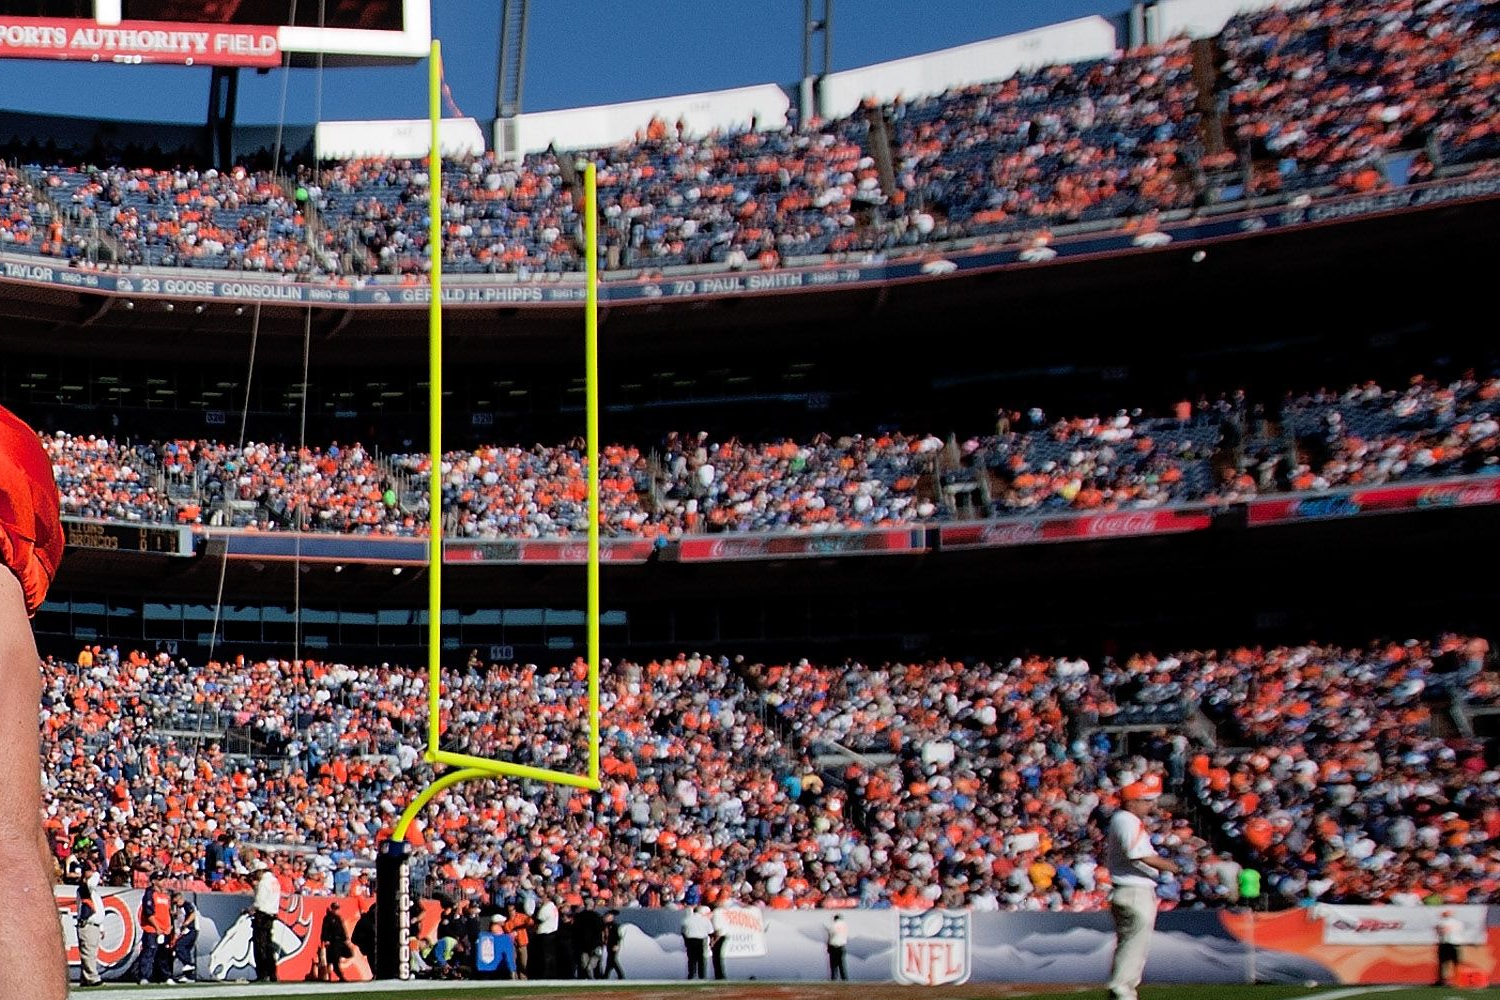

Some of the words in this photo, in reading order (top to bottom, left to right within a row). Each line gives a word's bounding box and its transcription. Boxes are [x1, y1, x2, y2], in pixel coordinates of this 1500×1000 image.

[71, 28, 209, 53] AUTHORITY
[214, 33, 278, 56] FIELD
[5, 262, 53, 281] TAYLOR
[141, 278, 160, 292] 23
[164, 279, 215, 295] GOOSE
[221, 283, 302, 299] GONSOULIN
[469, 288, 485, 301] H.
[486, 287, 543, 301] PHIPPS
[674, 279, 695, 295] 70
[703, 277, 746, 294] PAUL
[750, 272, 803, 289] SMITH
[69, 522, 105, 535] LIONS
[69, 534, 119, 550] BRONCOS
[140, 539, 148, 552] 0
[400, 863, 410, 980] BRONCOS
[905, 942, 962, 986] NFL
